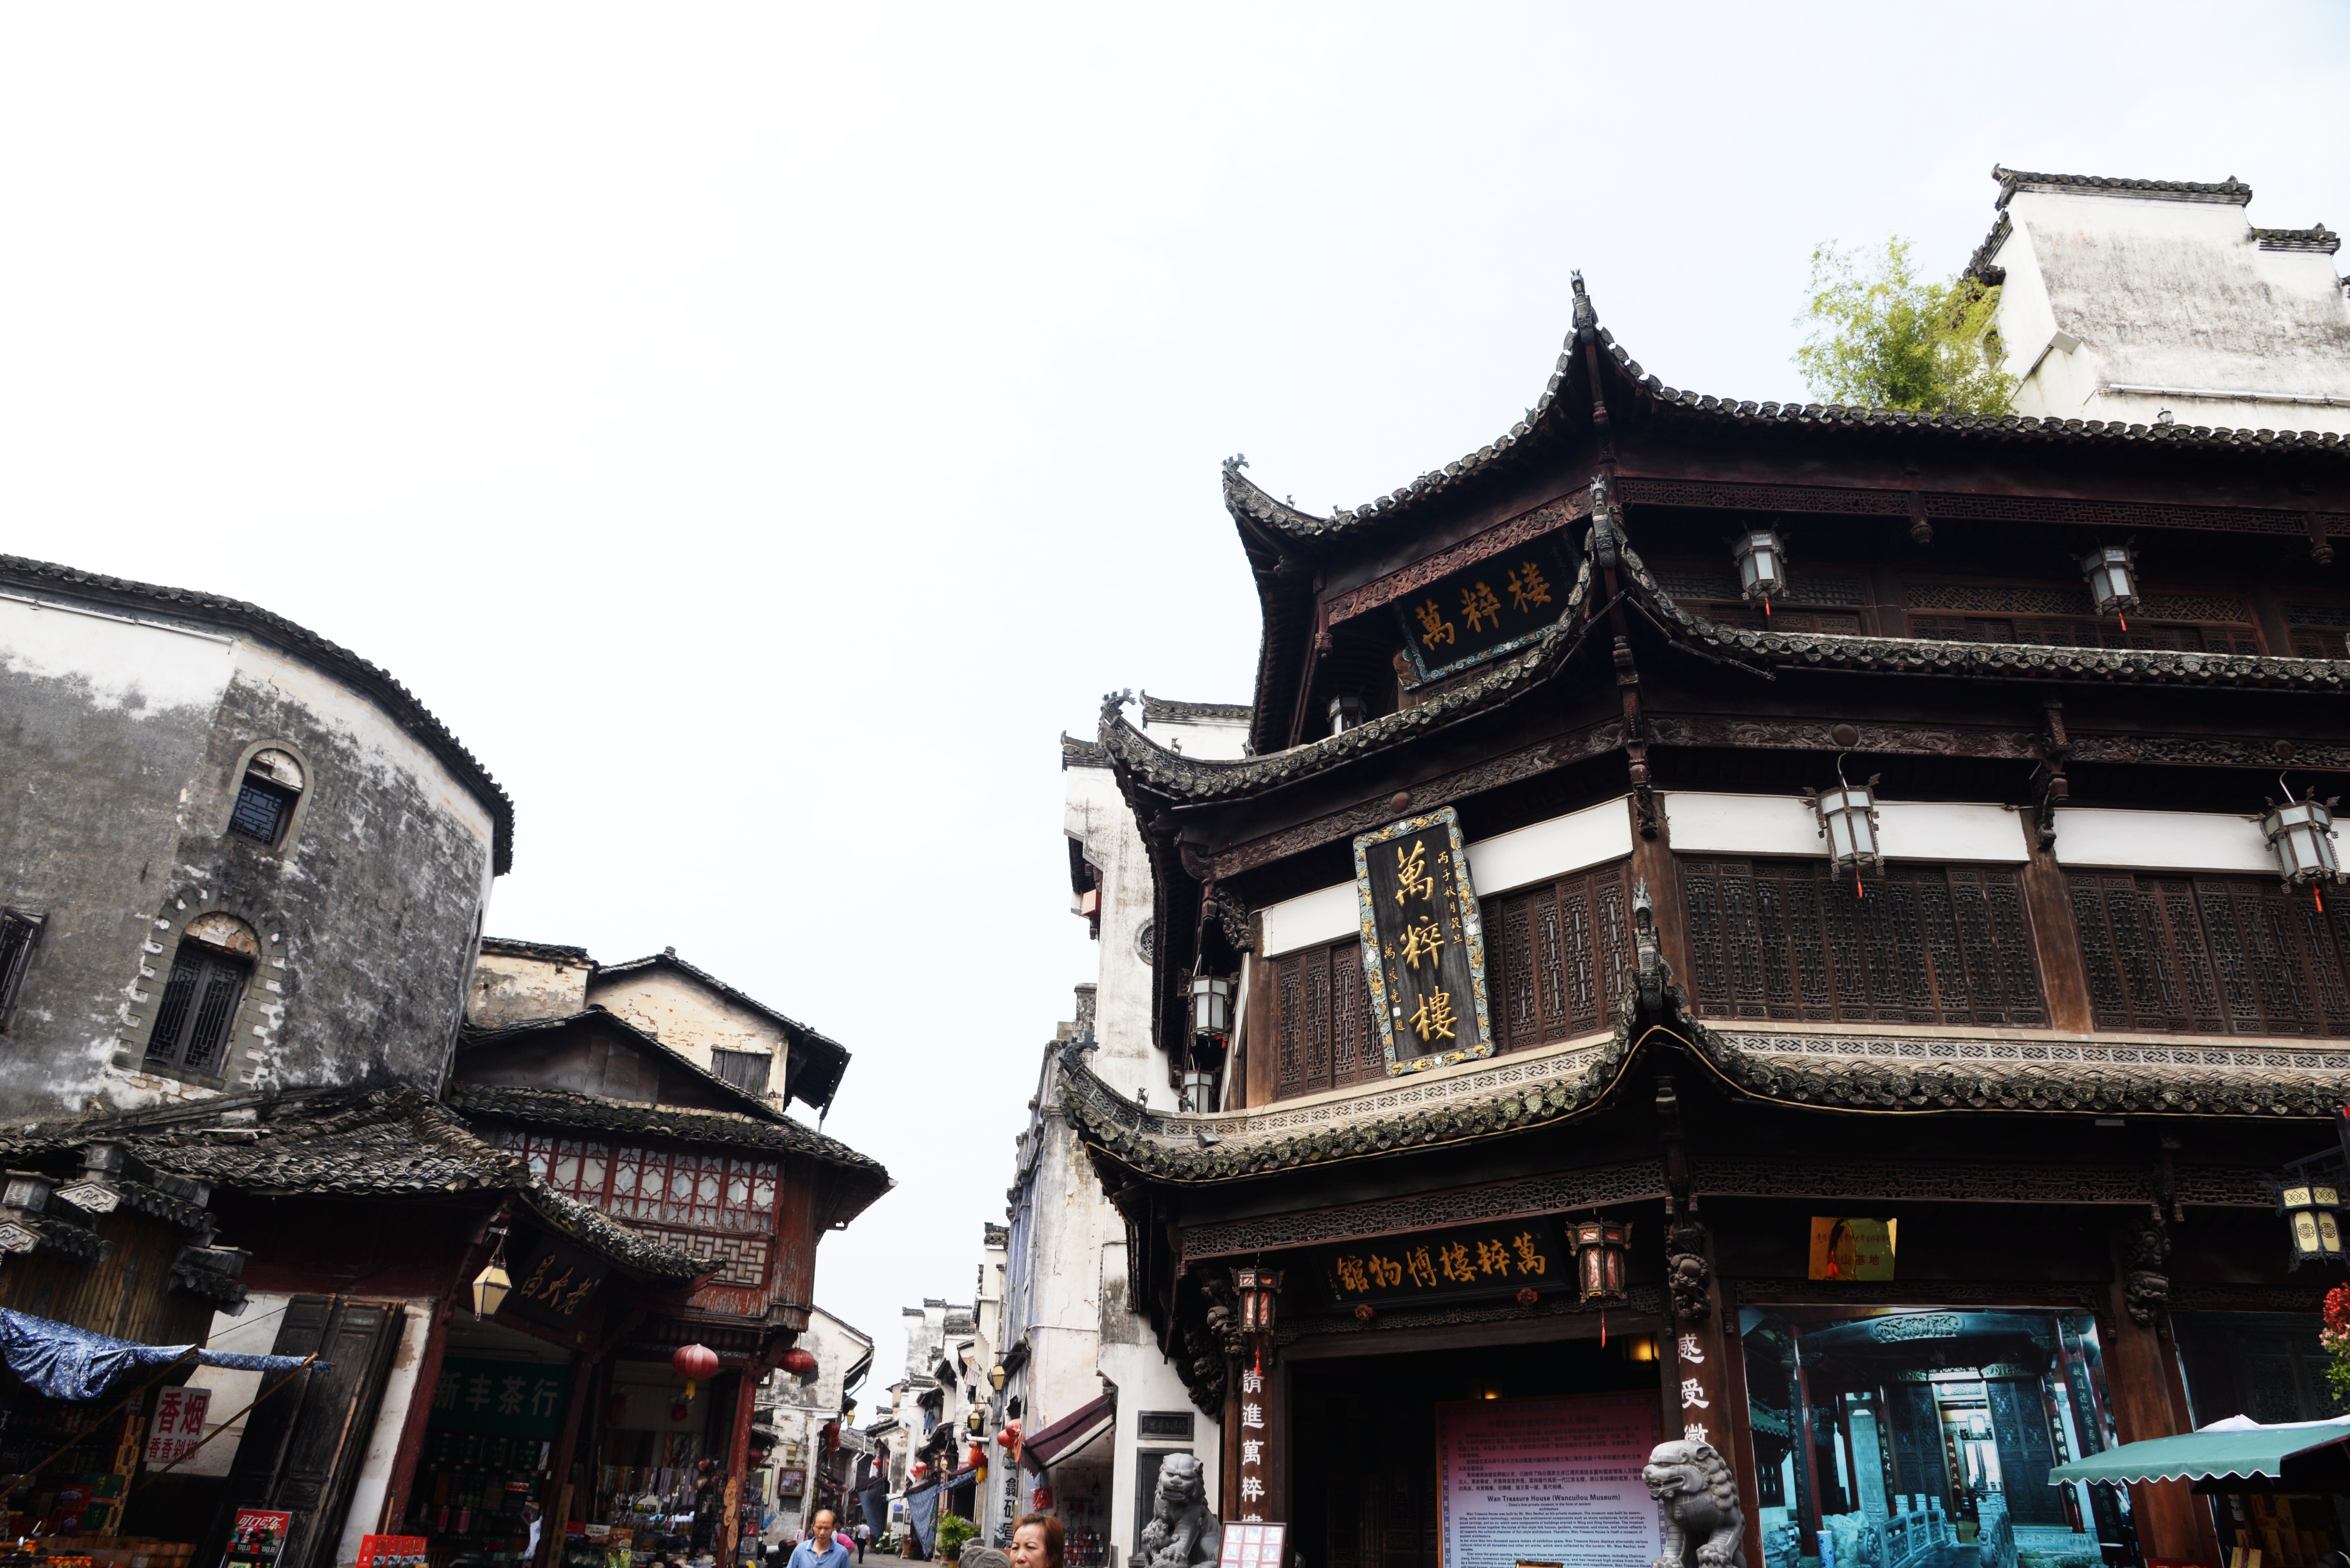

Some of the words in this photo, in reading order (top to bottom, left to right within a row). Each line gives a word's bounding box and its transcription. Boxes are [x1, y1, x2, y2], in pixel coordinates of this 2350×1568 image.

[1395, 840, 1457, 1042] 萬粹樓
[158, 1392, 207, 1435] 香烟
[433, 1371, 559, 1417] 新丰茶行
[149, 1438, 199, 1460] 香香剁椒
